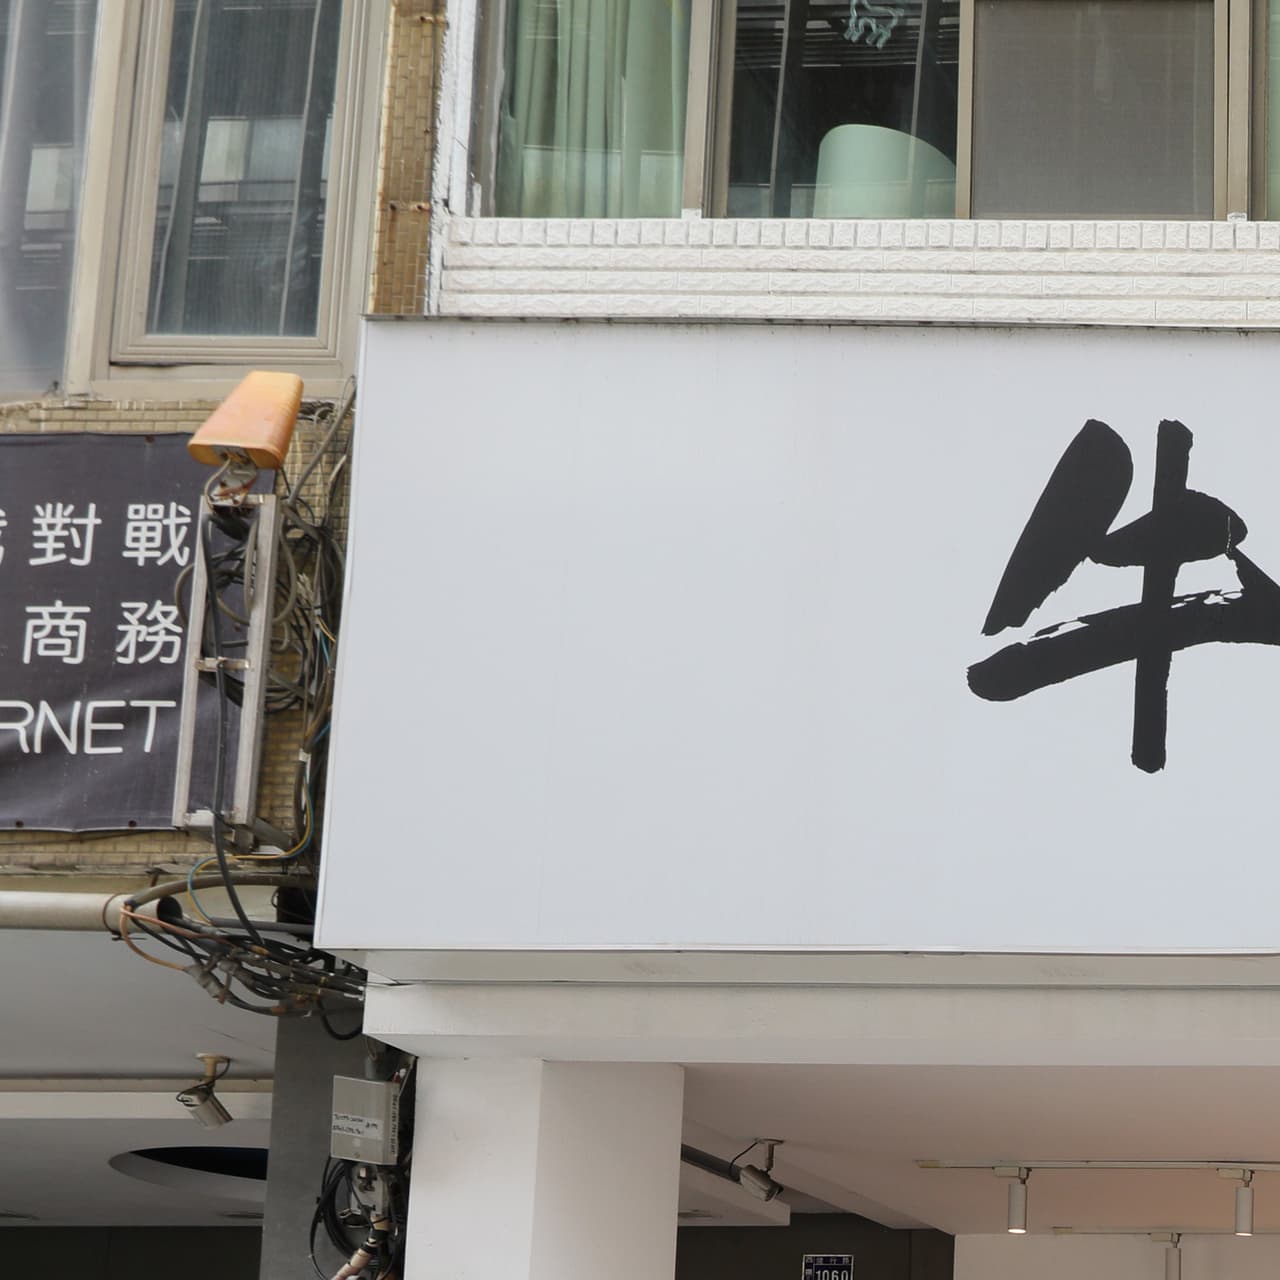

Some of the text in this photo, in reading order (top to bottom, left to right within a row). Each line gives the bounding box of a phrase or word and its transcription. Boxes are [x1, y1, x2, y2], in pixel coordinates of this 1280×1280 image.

[0, 502, 191, 567] 對戰
[23, 600, 184, 665] 商務
[0, 700, 177, 755] RNET
